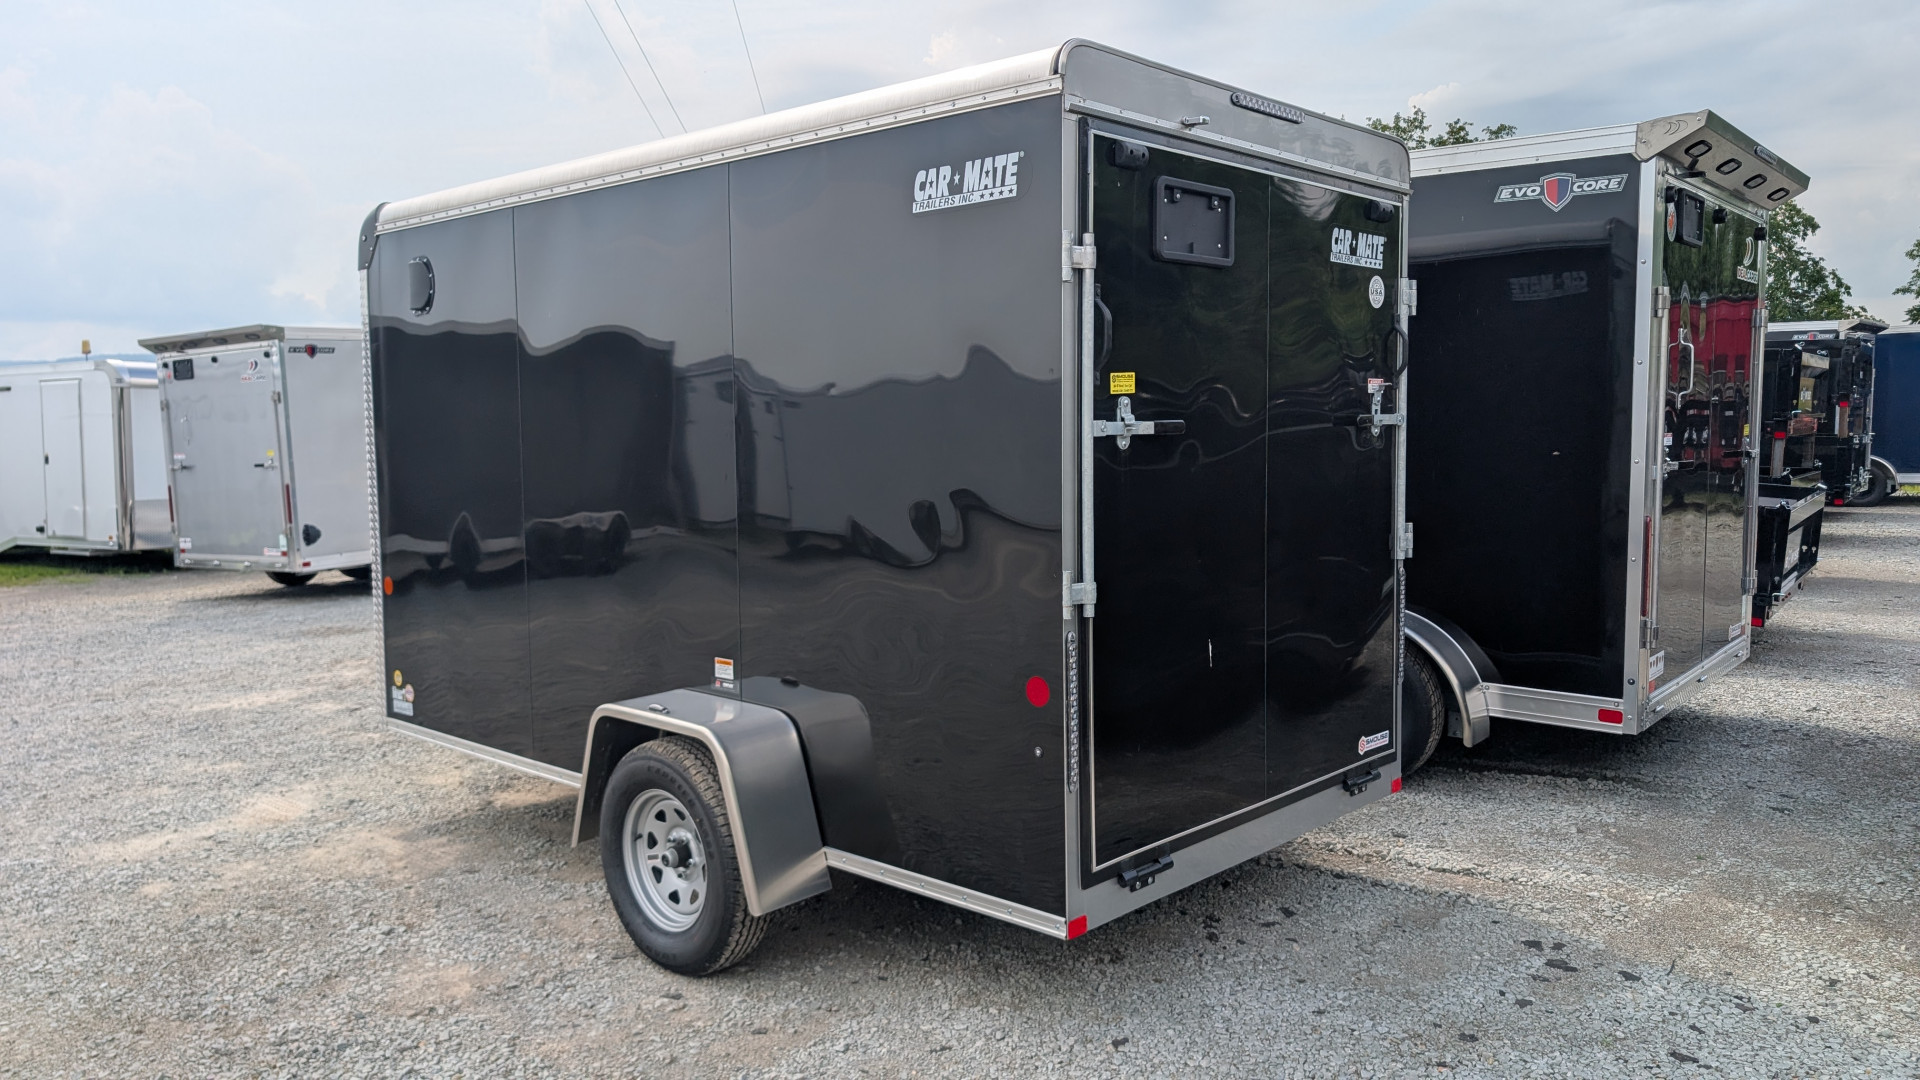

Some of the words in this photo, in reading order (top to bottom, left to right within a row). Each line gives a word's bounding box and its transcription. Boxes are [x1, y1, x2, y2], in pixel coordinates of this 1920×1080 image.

[914, 165, 952, 202] CAR
[1500, 186, 1541, 199] EVO
[1573, 178, 1622, 192] CORE
[914, 196, 956, 212] TRAILERS
[958, 193, 977, 204] INC.
[1332, 227, 1353, 255] CAR
[1331, 252, 1354, 264] TRAILERS
[1370, 288, 1383, 296] USA
[1366, 732, 1388, 745] SMOUSE
